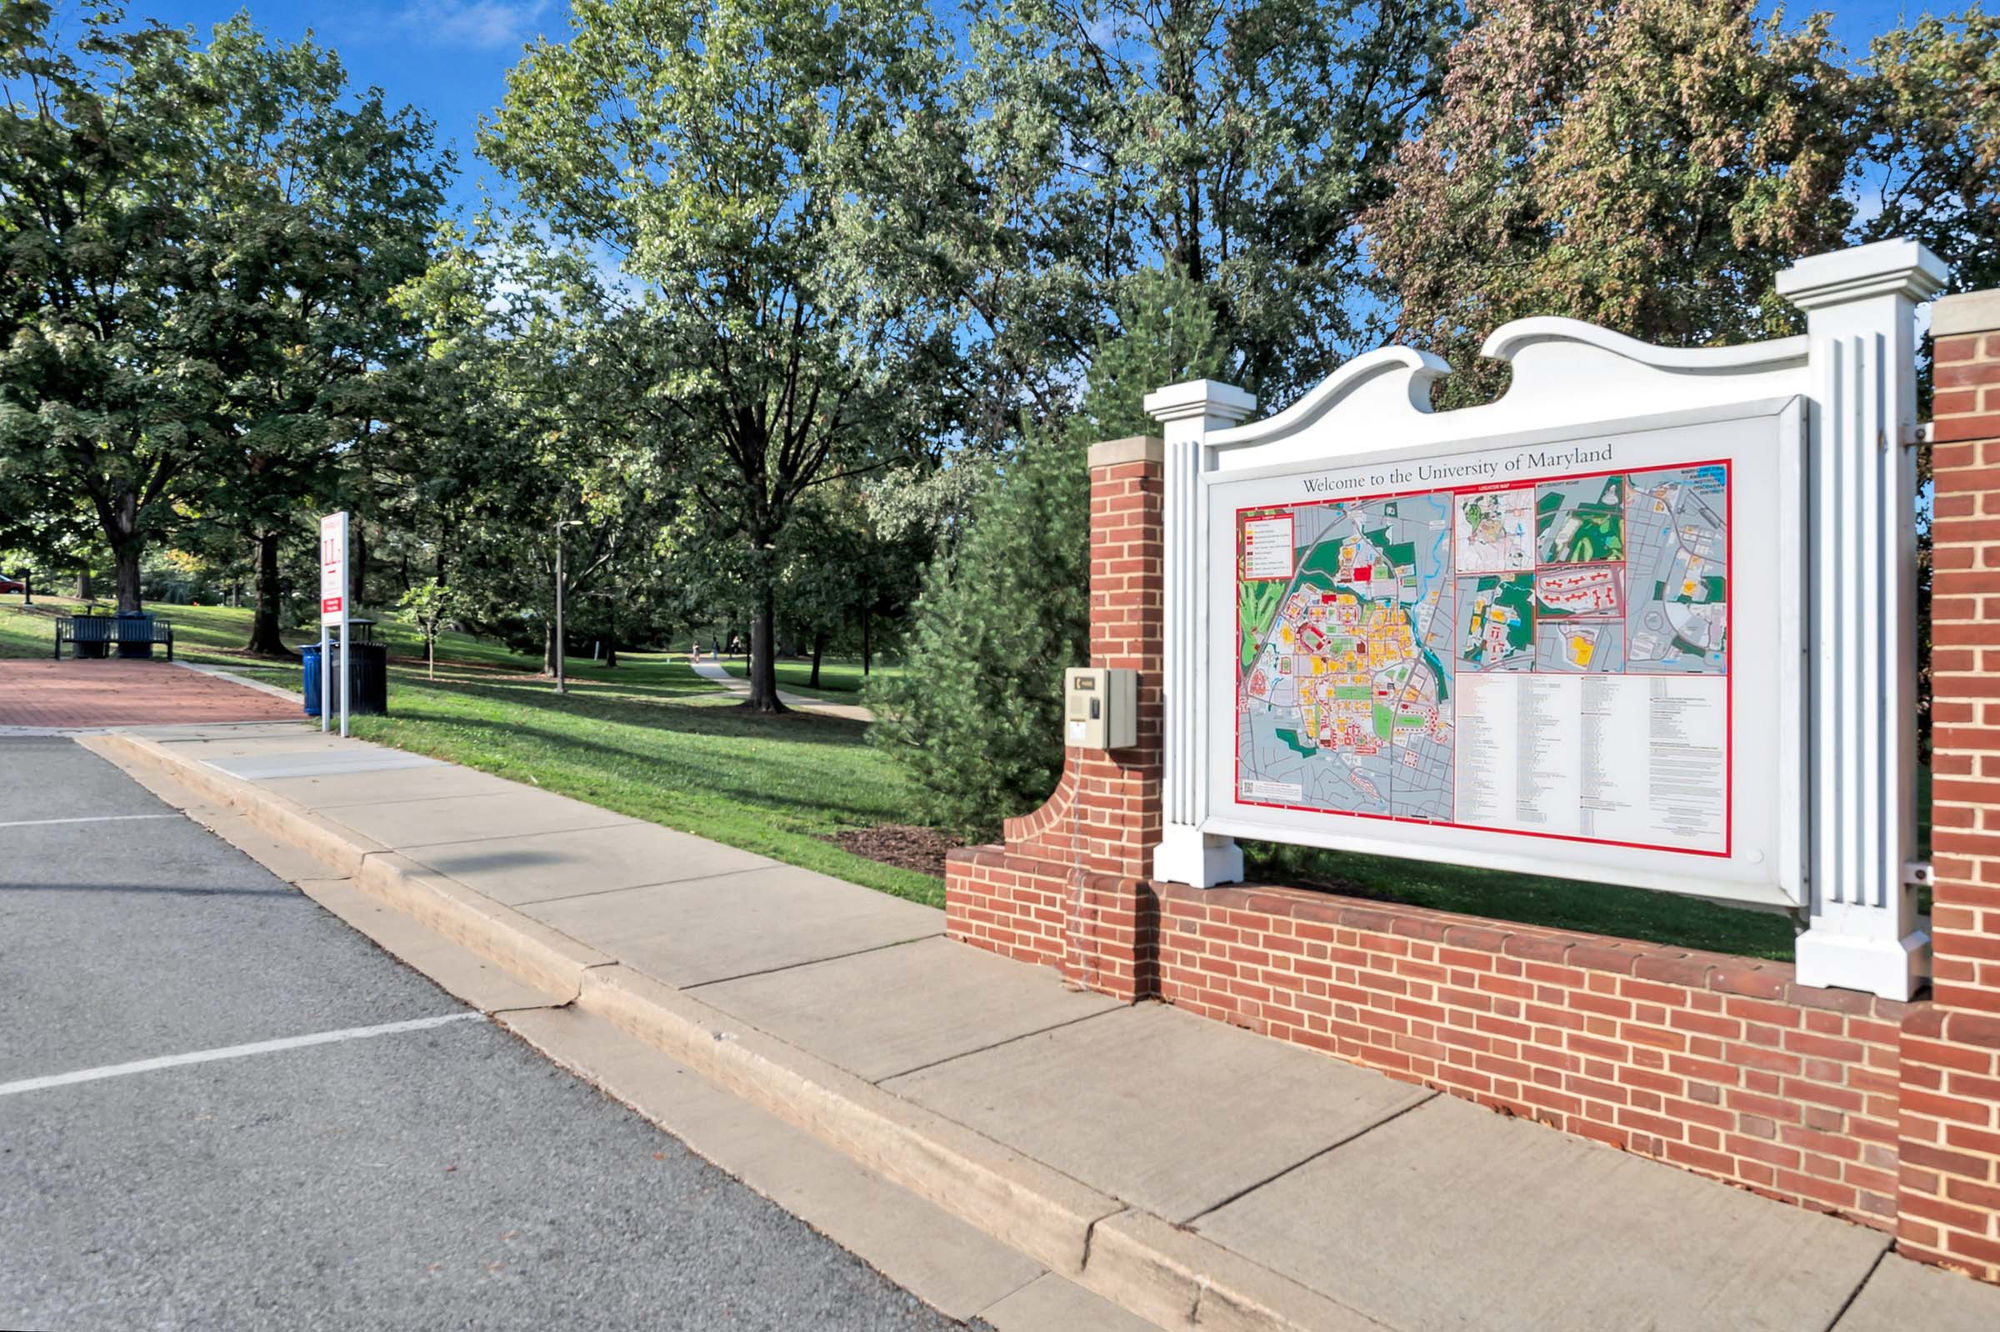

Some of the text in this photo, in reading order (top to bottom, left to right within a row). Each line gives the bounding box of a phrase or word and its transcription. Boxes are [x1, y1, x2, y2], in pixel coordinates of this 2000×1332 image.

[1303, 443, 1612, 493] Welcome to the University of Maryland
